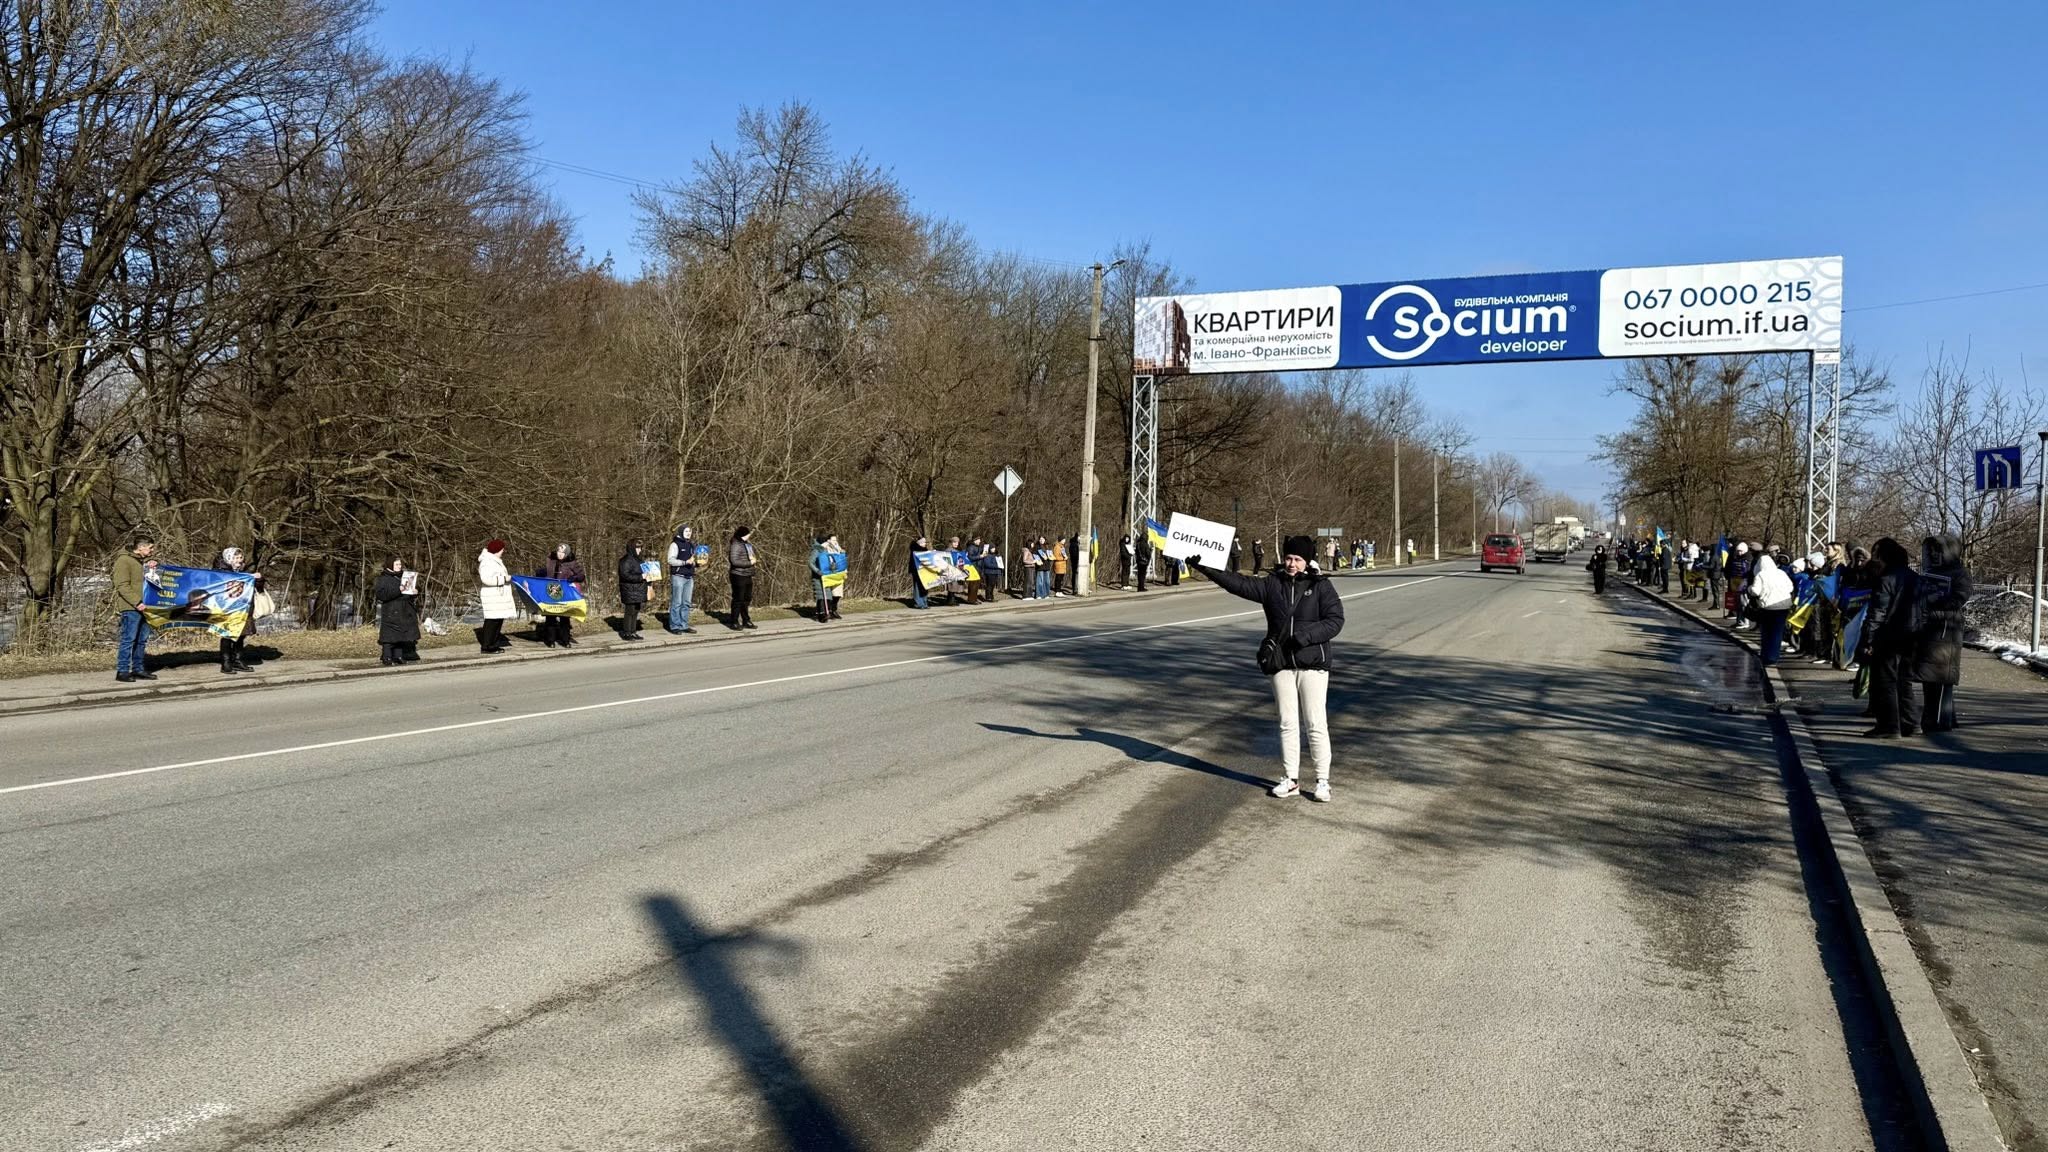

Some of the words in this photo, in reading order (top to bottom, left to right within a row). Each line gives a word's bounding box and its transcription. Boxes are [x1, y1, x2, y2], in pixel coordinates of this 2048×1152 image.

[1454, 296, 1514, 307] БУДІВЕЛЬНА
[1515, 293, 1568, 303] КОМПАНІЯ
[1624, 289, 1672, 310] 067
[1680, 284, 1758, 308] 0000
[1767, 281, 1812, 303] 215
[1194, 306, 1334, 334] КВАРТИРИ
[1623, 310, 1809, 339] socium.if.ua
[1194, 338, 1205, 346] та
[1206, 334, 1265, 346] комерційна
[1268, 331, 1333, 344] нерухомість
[1480, 338, 1567, 355] developer
[1193, 350, 1207, 360] м.
[1210, 344, 1332, 360] Івано-Франківськ
[1172, 531, 1225, 552] СИГНАЛЬ
